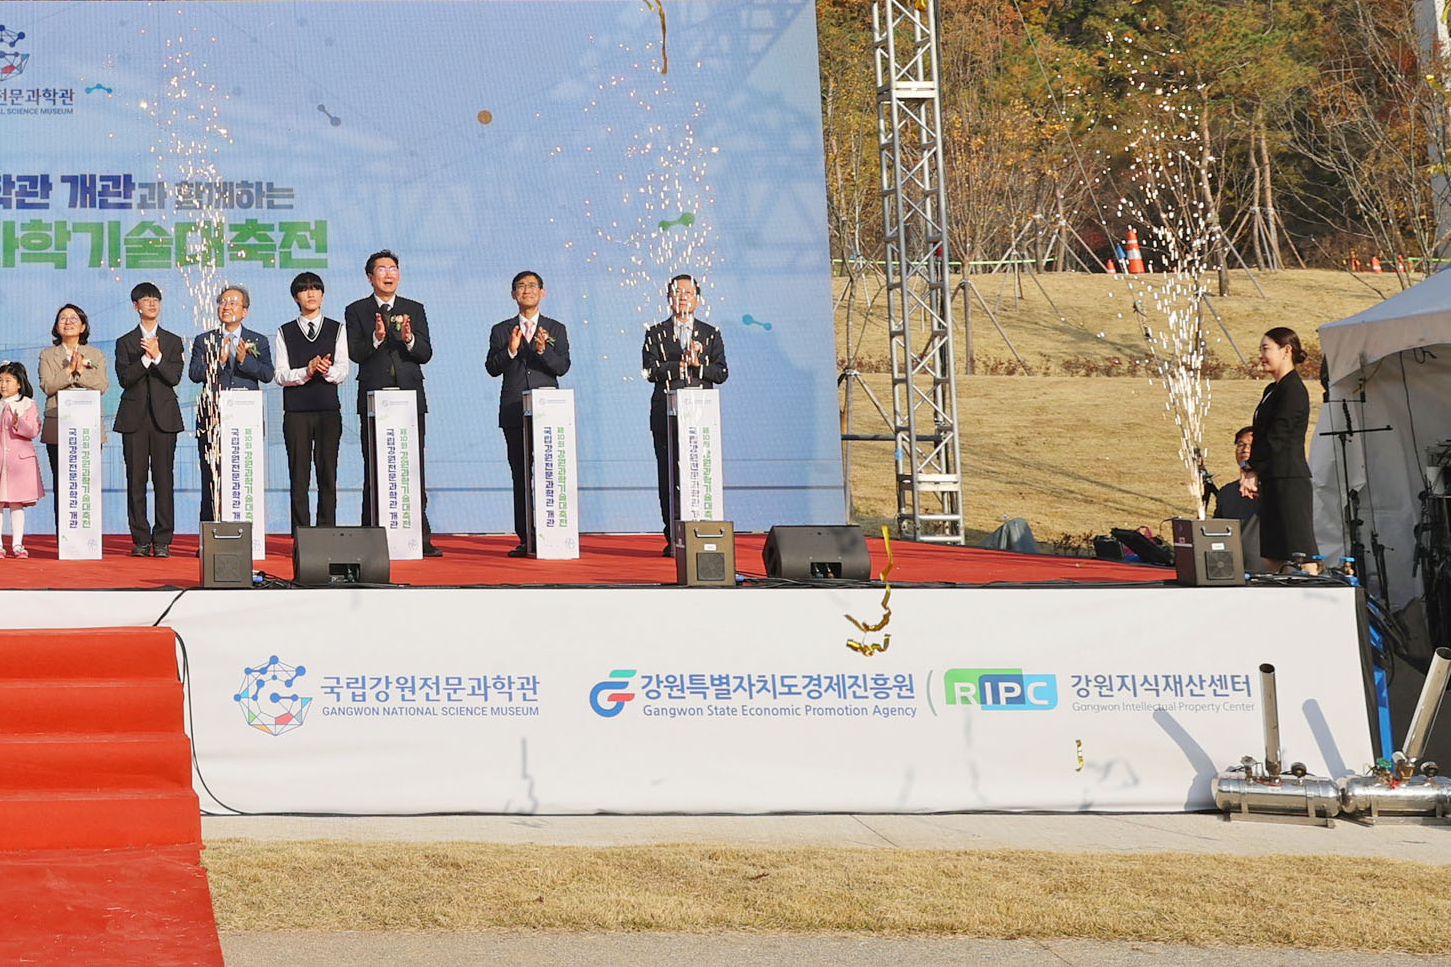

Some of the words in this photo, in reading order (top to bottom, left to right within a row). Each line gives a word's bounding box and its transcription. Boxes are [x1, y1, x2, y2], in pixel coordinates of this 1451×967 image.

[320, 675, 540, 703] 국립강원전문과학관
[641, 673, 916, 700] 강원특별자치도경제진흥원
[953, 681, 1049, 706] RIPC
[1070, 674, 1252, 698] 강원지식재산센터
[322, 706, 381, 716] GANGWON
[383, 706, 438, 716] NATIONAL
[441, 706, 488, 716] SCIENCE
[491, 706, 540, 716] MUSEUM
[643, 705, 704, 719] Gangwon
[707, 705, 738, 716] State
[742, 705, 801, 716] Economic
[805, 705, 869, 716] Promotion
[872, 705, 917, 719] Agency
[1072, 702, 1121, 713] Gangwon
[1122, 701, 1176, 712] Intellectual
[1178, 701, 1222, 714] Property
[1223, 701, 1255, 712] Center
